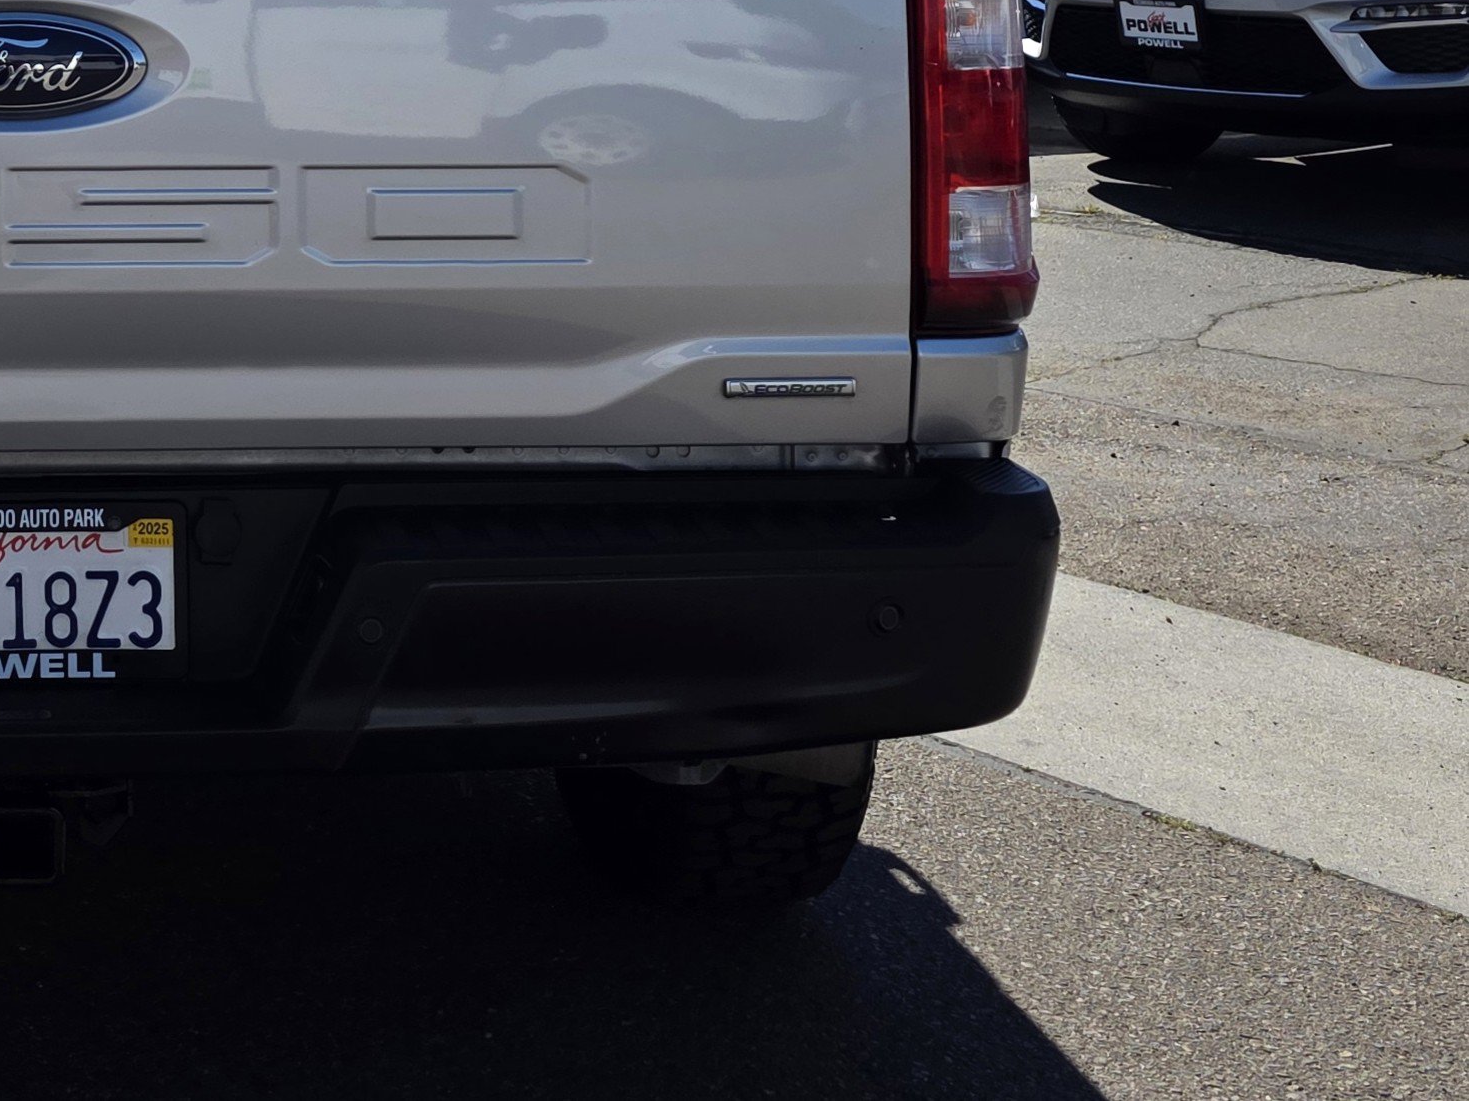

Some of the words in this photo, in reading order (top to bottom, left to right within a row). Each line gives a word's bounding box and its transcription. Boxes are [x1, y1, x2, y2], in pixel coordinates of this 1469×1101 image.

[1125, 18, 1196, 35] POWELL
[1137, 37, 1184, 49] POWELL
[19, 508, 60, 529] AUTO
[64, 508, 105, 528] PARK
[138, 521, 169, 535] 2025
